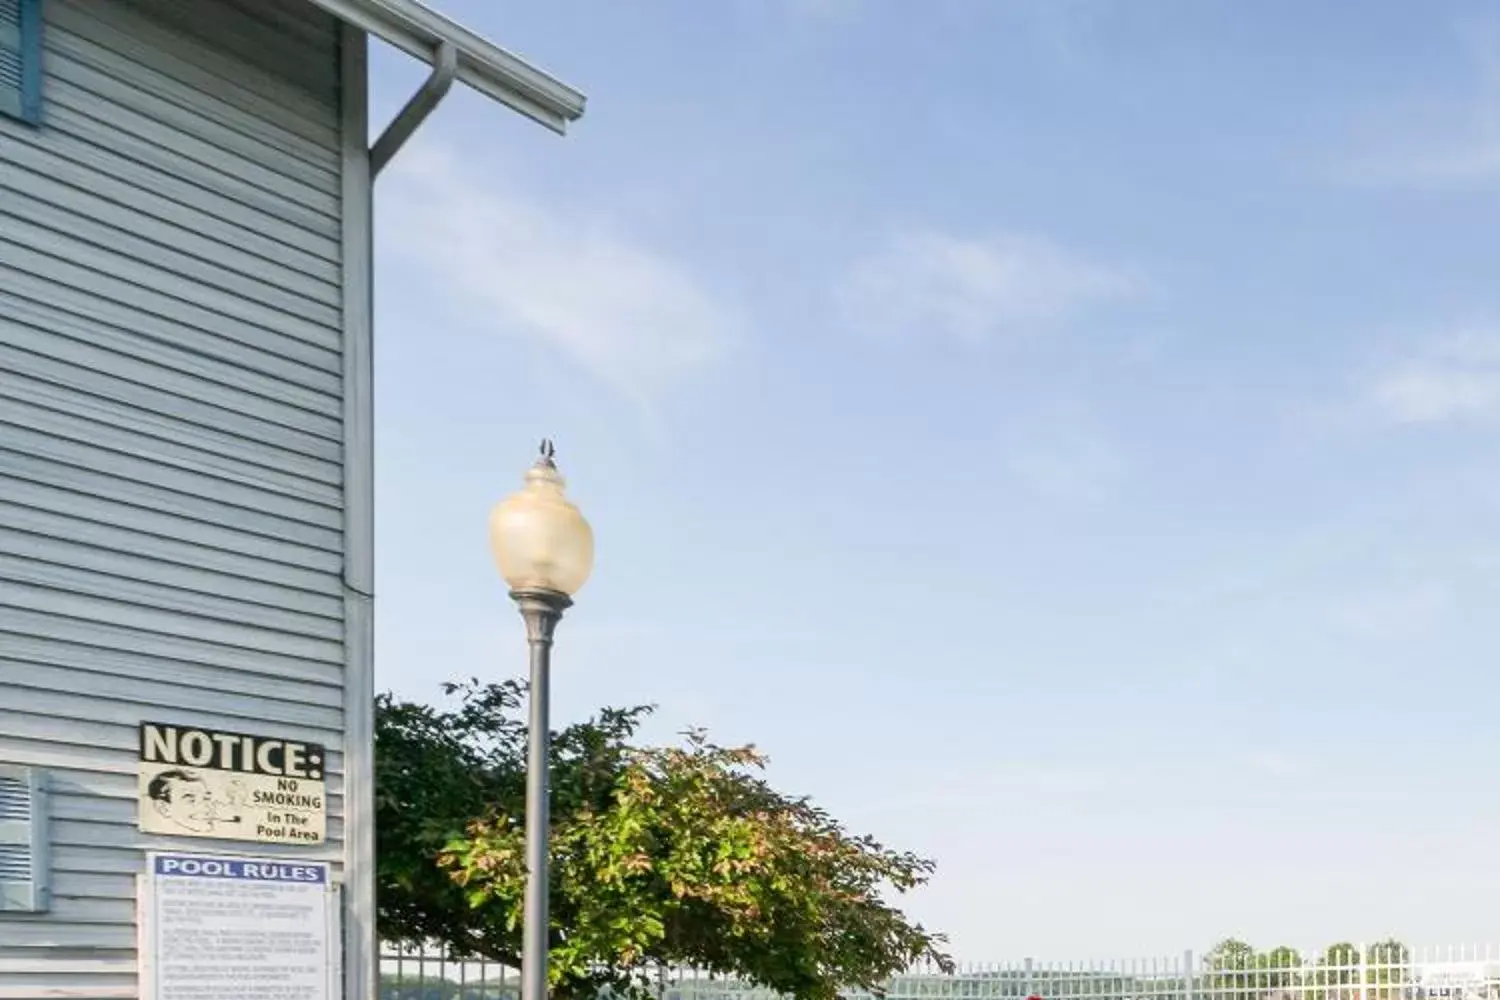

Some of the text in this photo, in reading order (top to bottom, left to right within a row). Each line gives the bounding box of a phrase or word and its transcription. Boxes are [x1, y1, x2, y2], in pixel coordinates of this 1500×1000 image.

[143, 724, 321, 779] NOTICE:
[277, 779, 298, 793] NO
[253, 791, 321, 809] SMOKING
[267, 812, 309, 826] In The
[257, 825, 319, 841] Pool Area
[162, 859, 319, 881] POOL RULES
